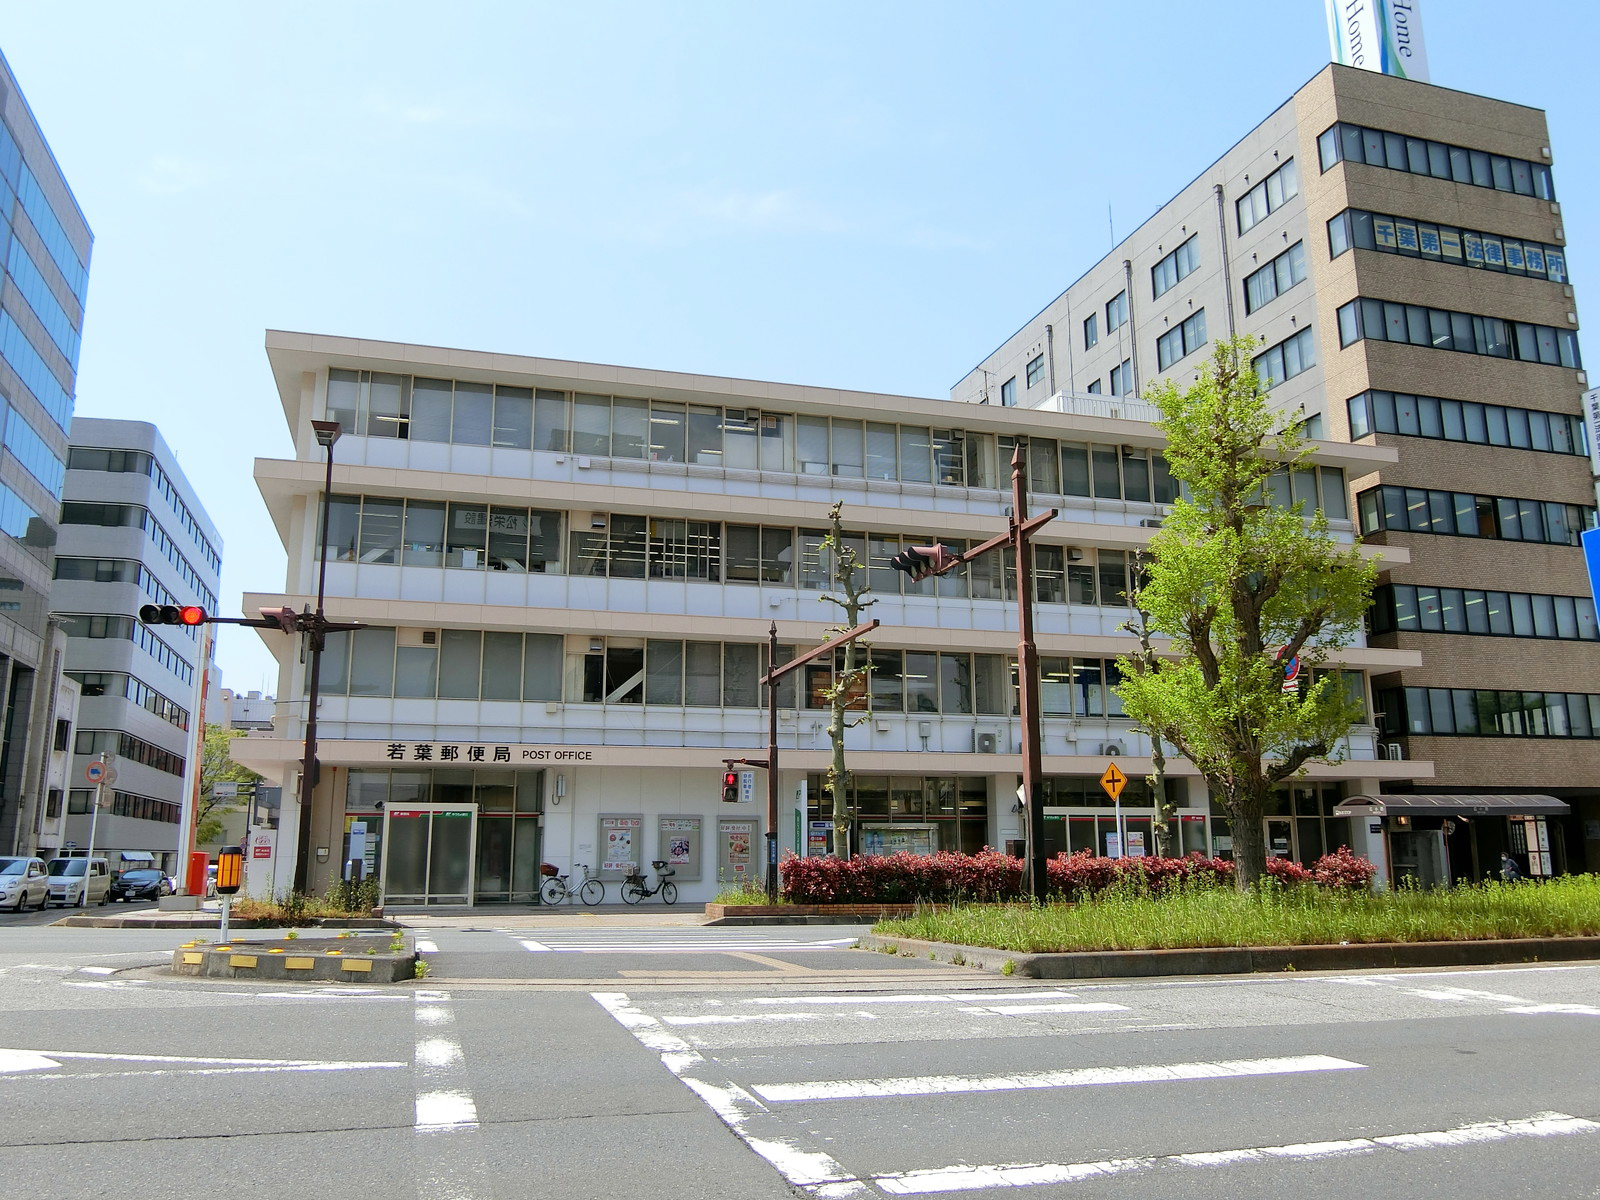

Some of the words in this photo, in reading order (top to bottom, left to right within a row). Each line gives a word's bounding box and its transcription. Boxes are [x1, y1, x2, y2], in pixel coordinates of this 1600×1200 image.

[1346, 0, 1365, 68] Home
[1377, 224, 1563, 275] 千葉第一法律事務所
[387, 743, 511, 763] 若葉郵便局
[522, 750, 551, 760] POST
[554, 750, 592, 761] OFFICE
